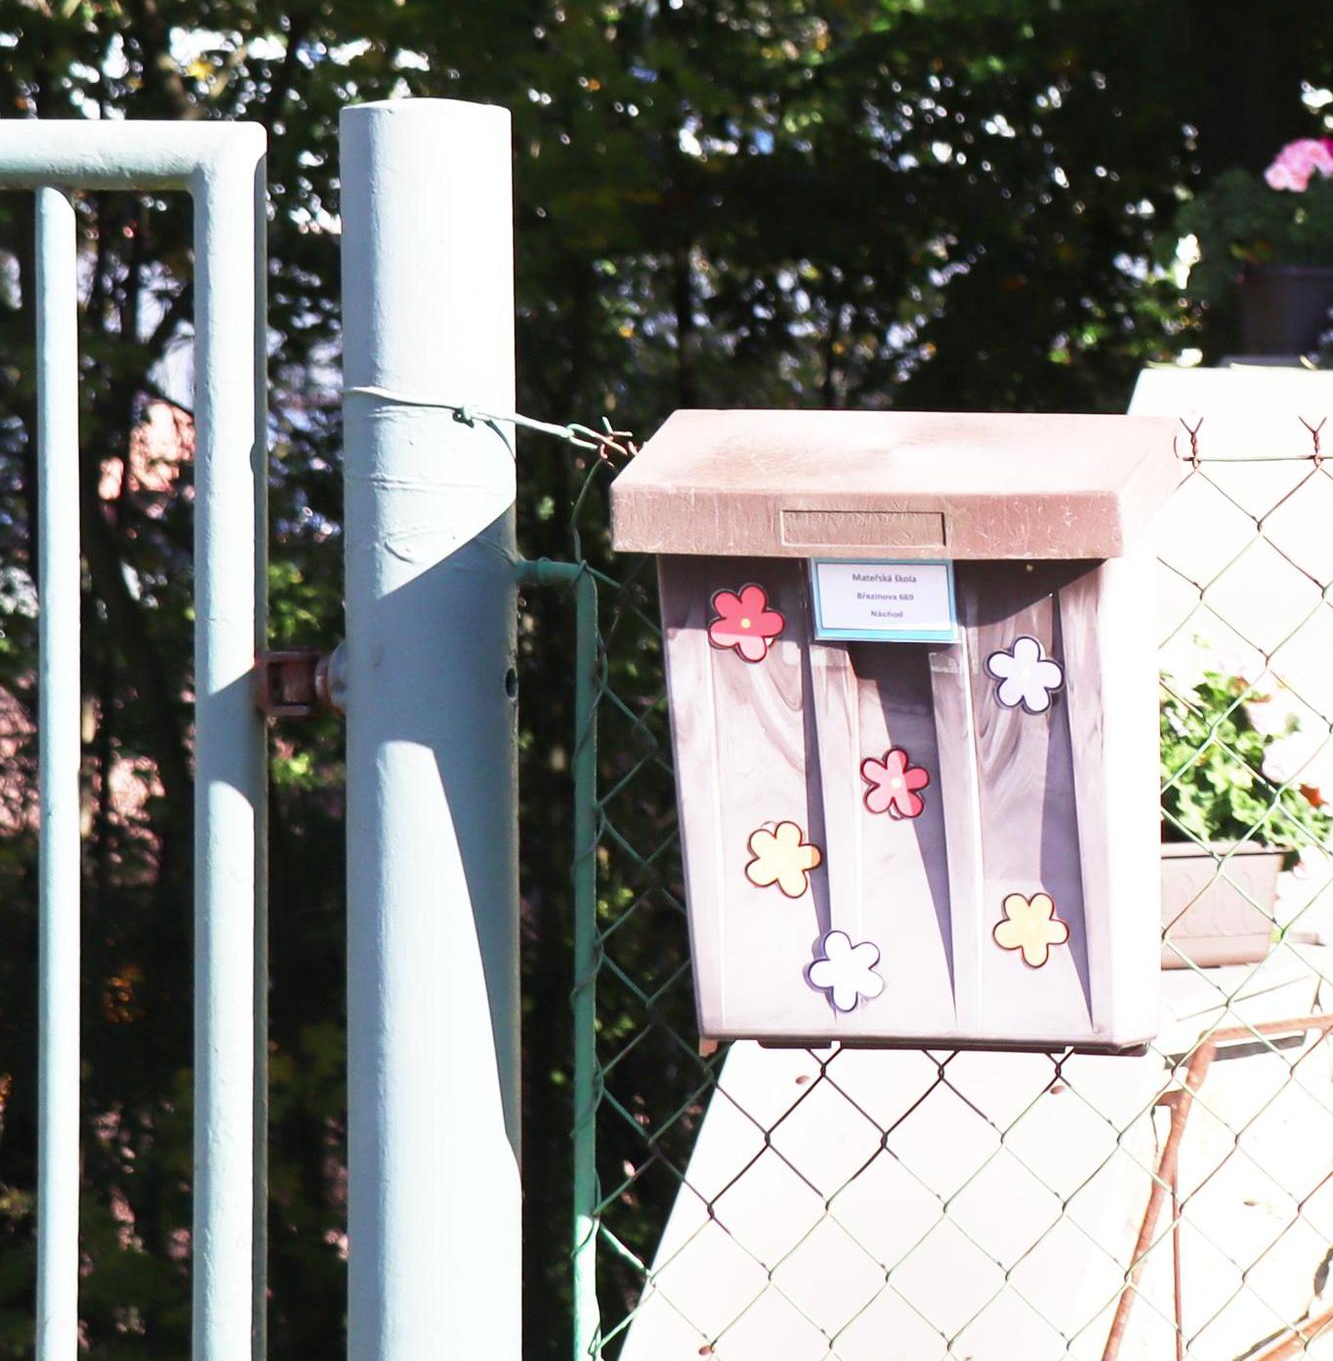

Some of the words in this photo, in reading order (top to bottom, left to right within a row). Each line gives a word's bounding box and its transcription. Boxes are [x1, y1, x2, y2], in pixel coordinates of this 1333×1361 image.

[852, 573, 892, 583] Mateřská
[895, 573, 917, 583] škola
[871, 610, 904, 618] Náchod
